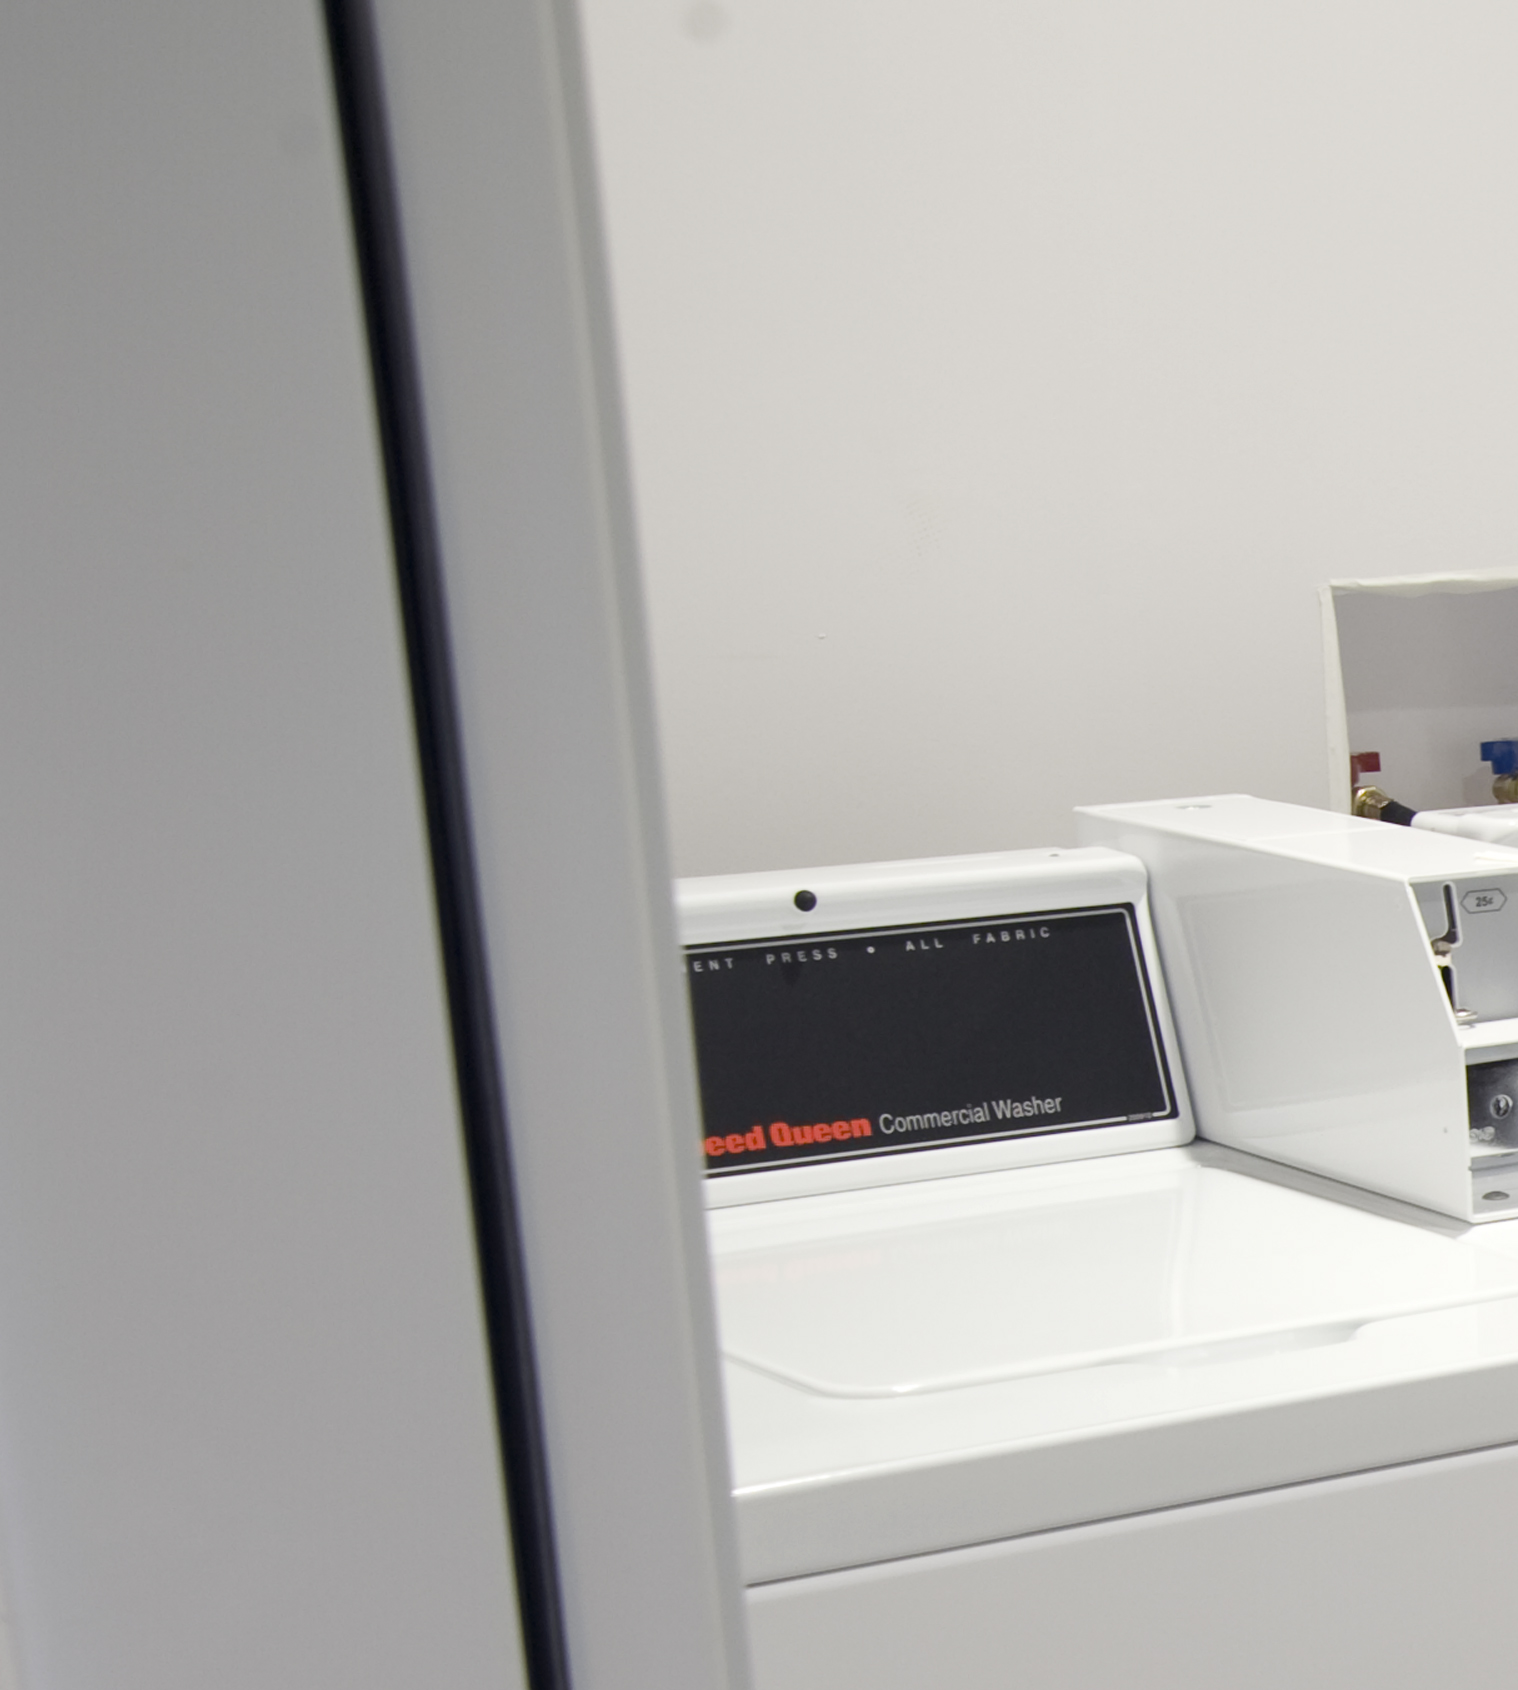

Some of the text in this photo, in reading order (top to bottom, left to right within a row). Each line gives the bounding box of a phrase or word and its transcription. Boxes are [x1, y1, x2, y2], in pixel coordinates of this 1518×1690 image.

[766, 926, 1050, 965] PRESS ALL FABRIC
[701, 1096, 1063, 1156] eed Queen Commercial Washer
